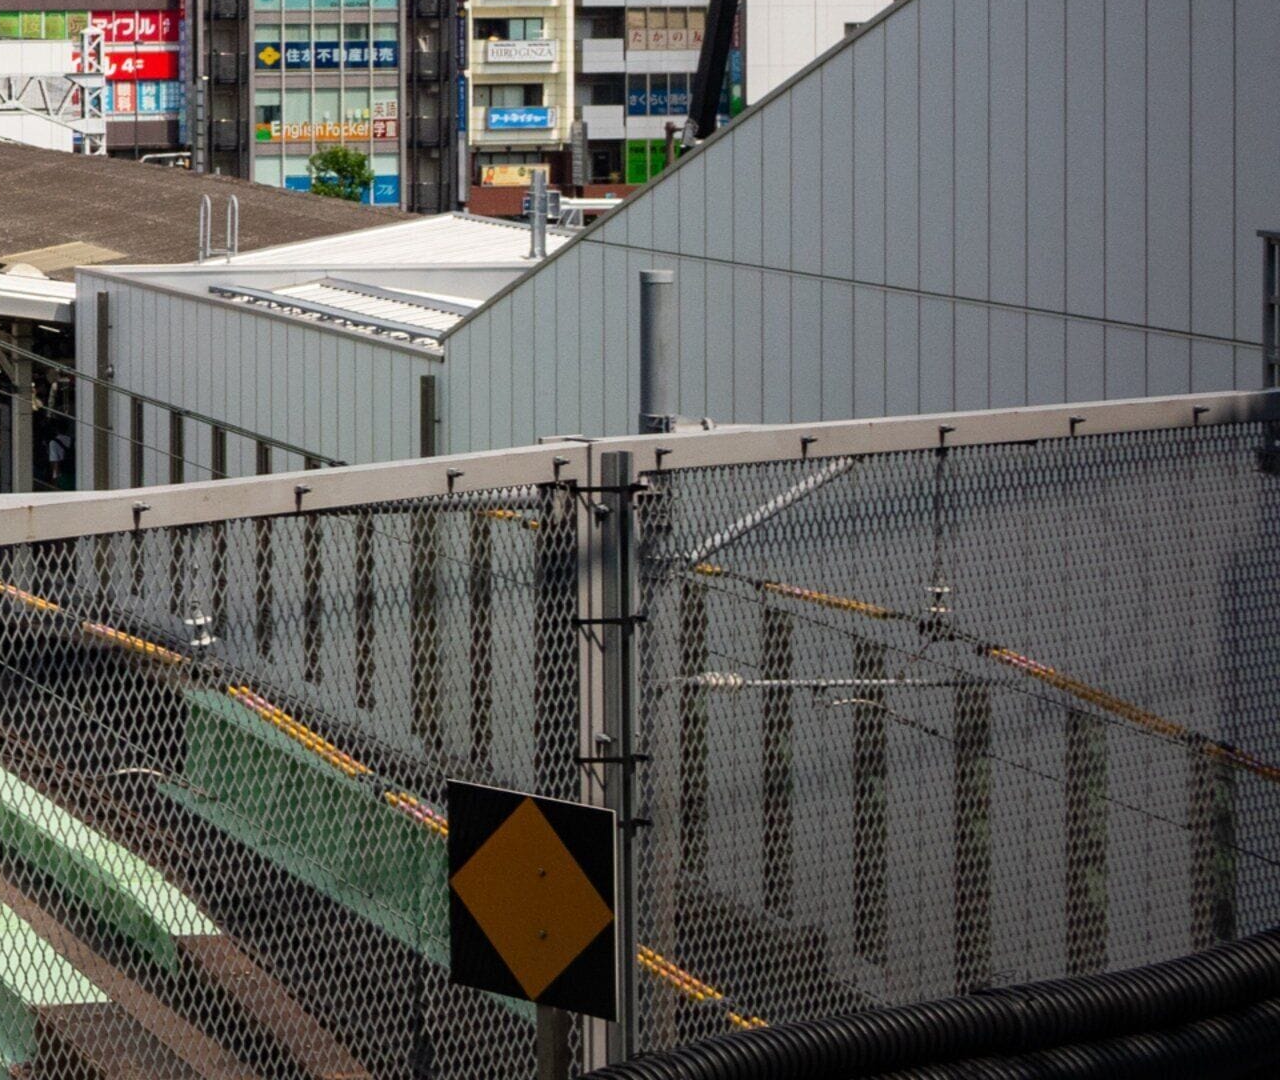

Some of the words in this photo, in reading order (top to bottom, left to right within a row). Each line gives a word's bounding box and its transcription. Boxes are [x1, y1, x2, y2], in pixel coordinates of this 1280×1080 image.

[286, 47, 395, 63] 住友不動産販売
[490, 46, 516, 58] HIRO
[517, 46, 553, 58] GINZA
[373, 101, 397, 118] 英語
[270, 120, 325, 139] English
[326, 121, 370, 137] Pocket
